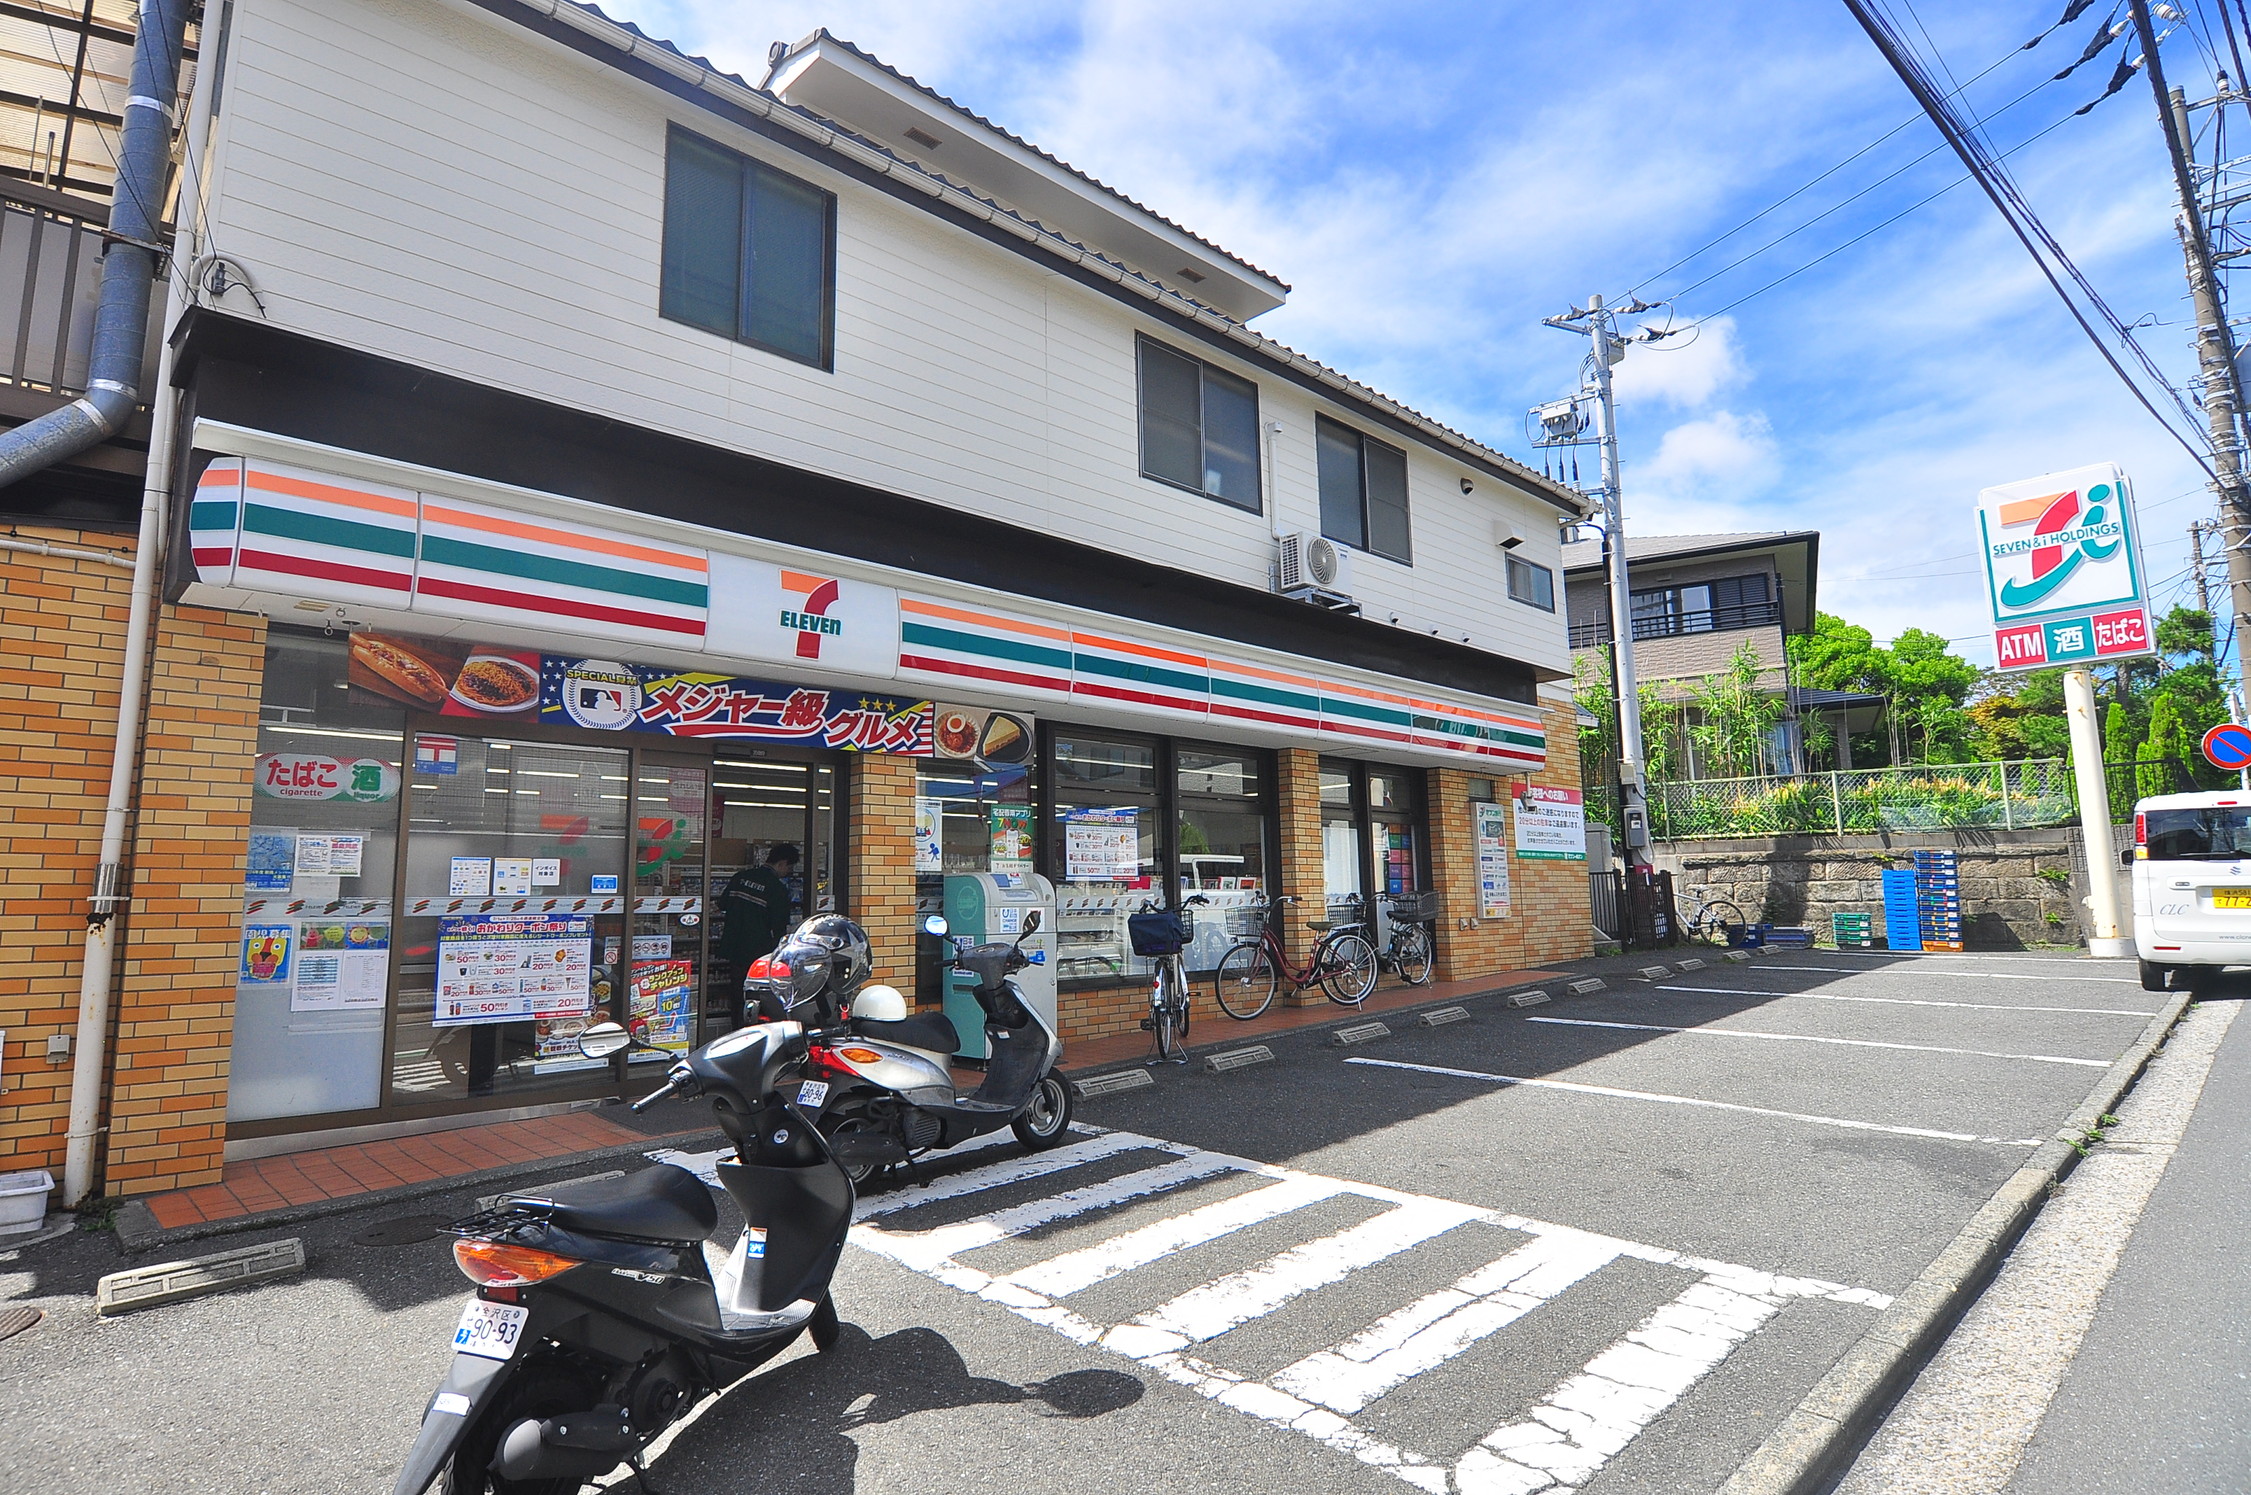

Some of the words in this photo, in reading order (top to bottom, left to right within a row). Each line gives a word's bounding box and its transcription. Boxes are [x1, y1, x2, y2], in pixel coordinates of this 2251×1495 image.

[2050, 522, 2120, 546] HOLDINGS
[2000, 631, 2043, 661] ATM
[2053, 625, 2085, 654] 酒
[2095, 617, 2145, 648] たばこ
[641, 686, 826, 728] メジャー級
[826, 711, 923, 747] グルメ
[266, 759, 337, 788] たばこ
[351, 764, 382, 792] 酒
[280, 788, 323, 797] cigarette
[353, 791, 380, 800] liquor
[2160, 904, 2190, 915] CLC
[470, 1318, 518, 1345] 90-93
